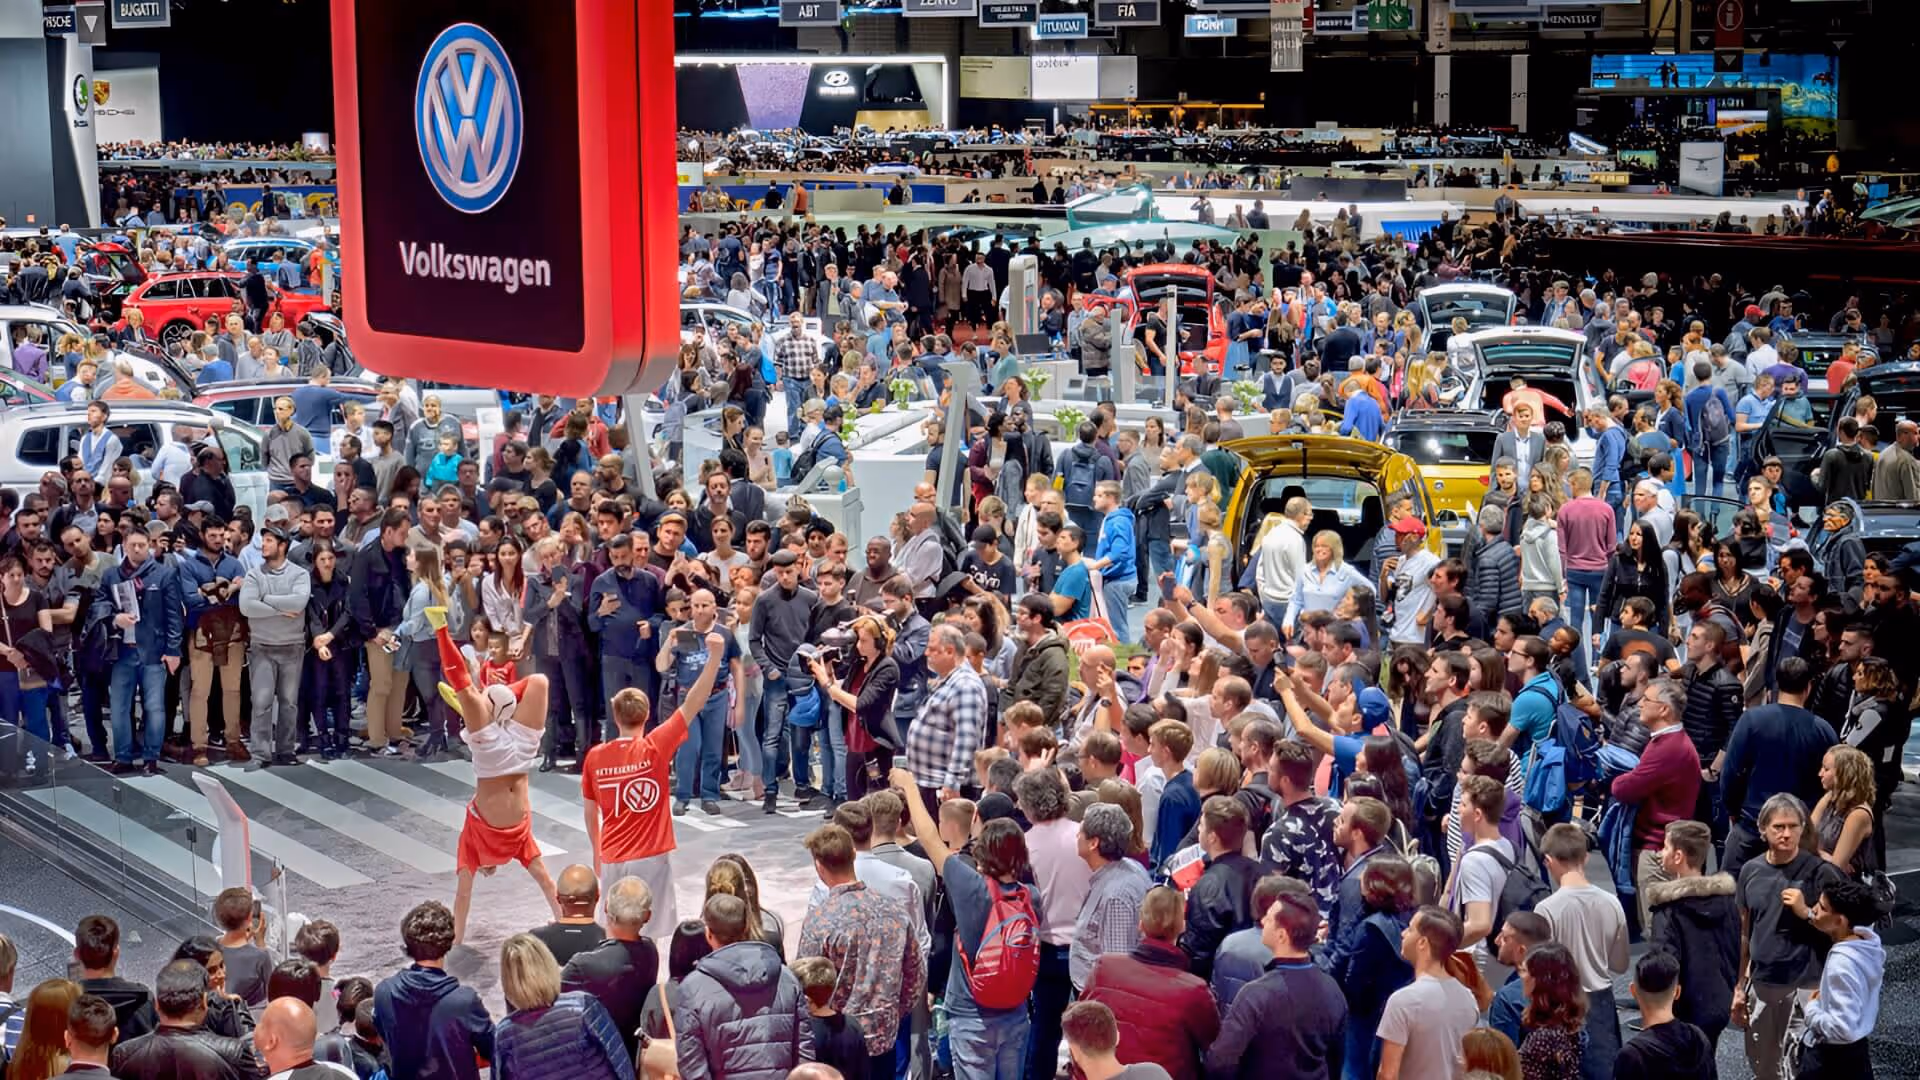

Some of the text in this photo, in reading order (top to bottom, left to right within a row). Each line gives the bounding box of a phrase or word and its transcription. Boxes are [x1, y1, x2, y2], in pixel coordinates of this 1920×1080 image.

[121, 2, 159, 17] BUGATTI
[798, 5, 820, 18] ABT
[1117, 5, 1136, 17] FIA
[399, 240, 551, 294] Volkswagen
